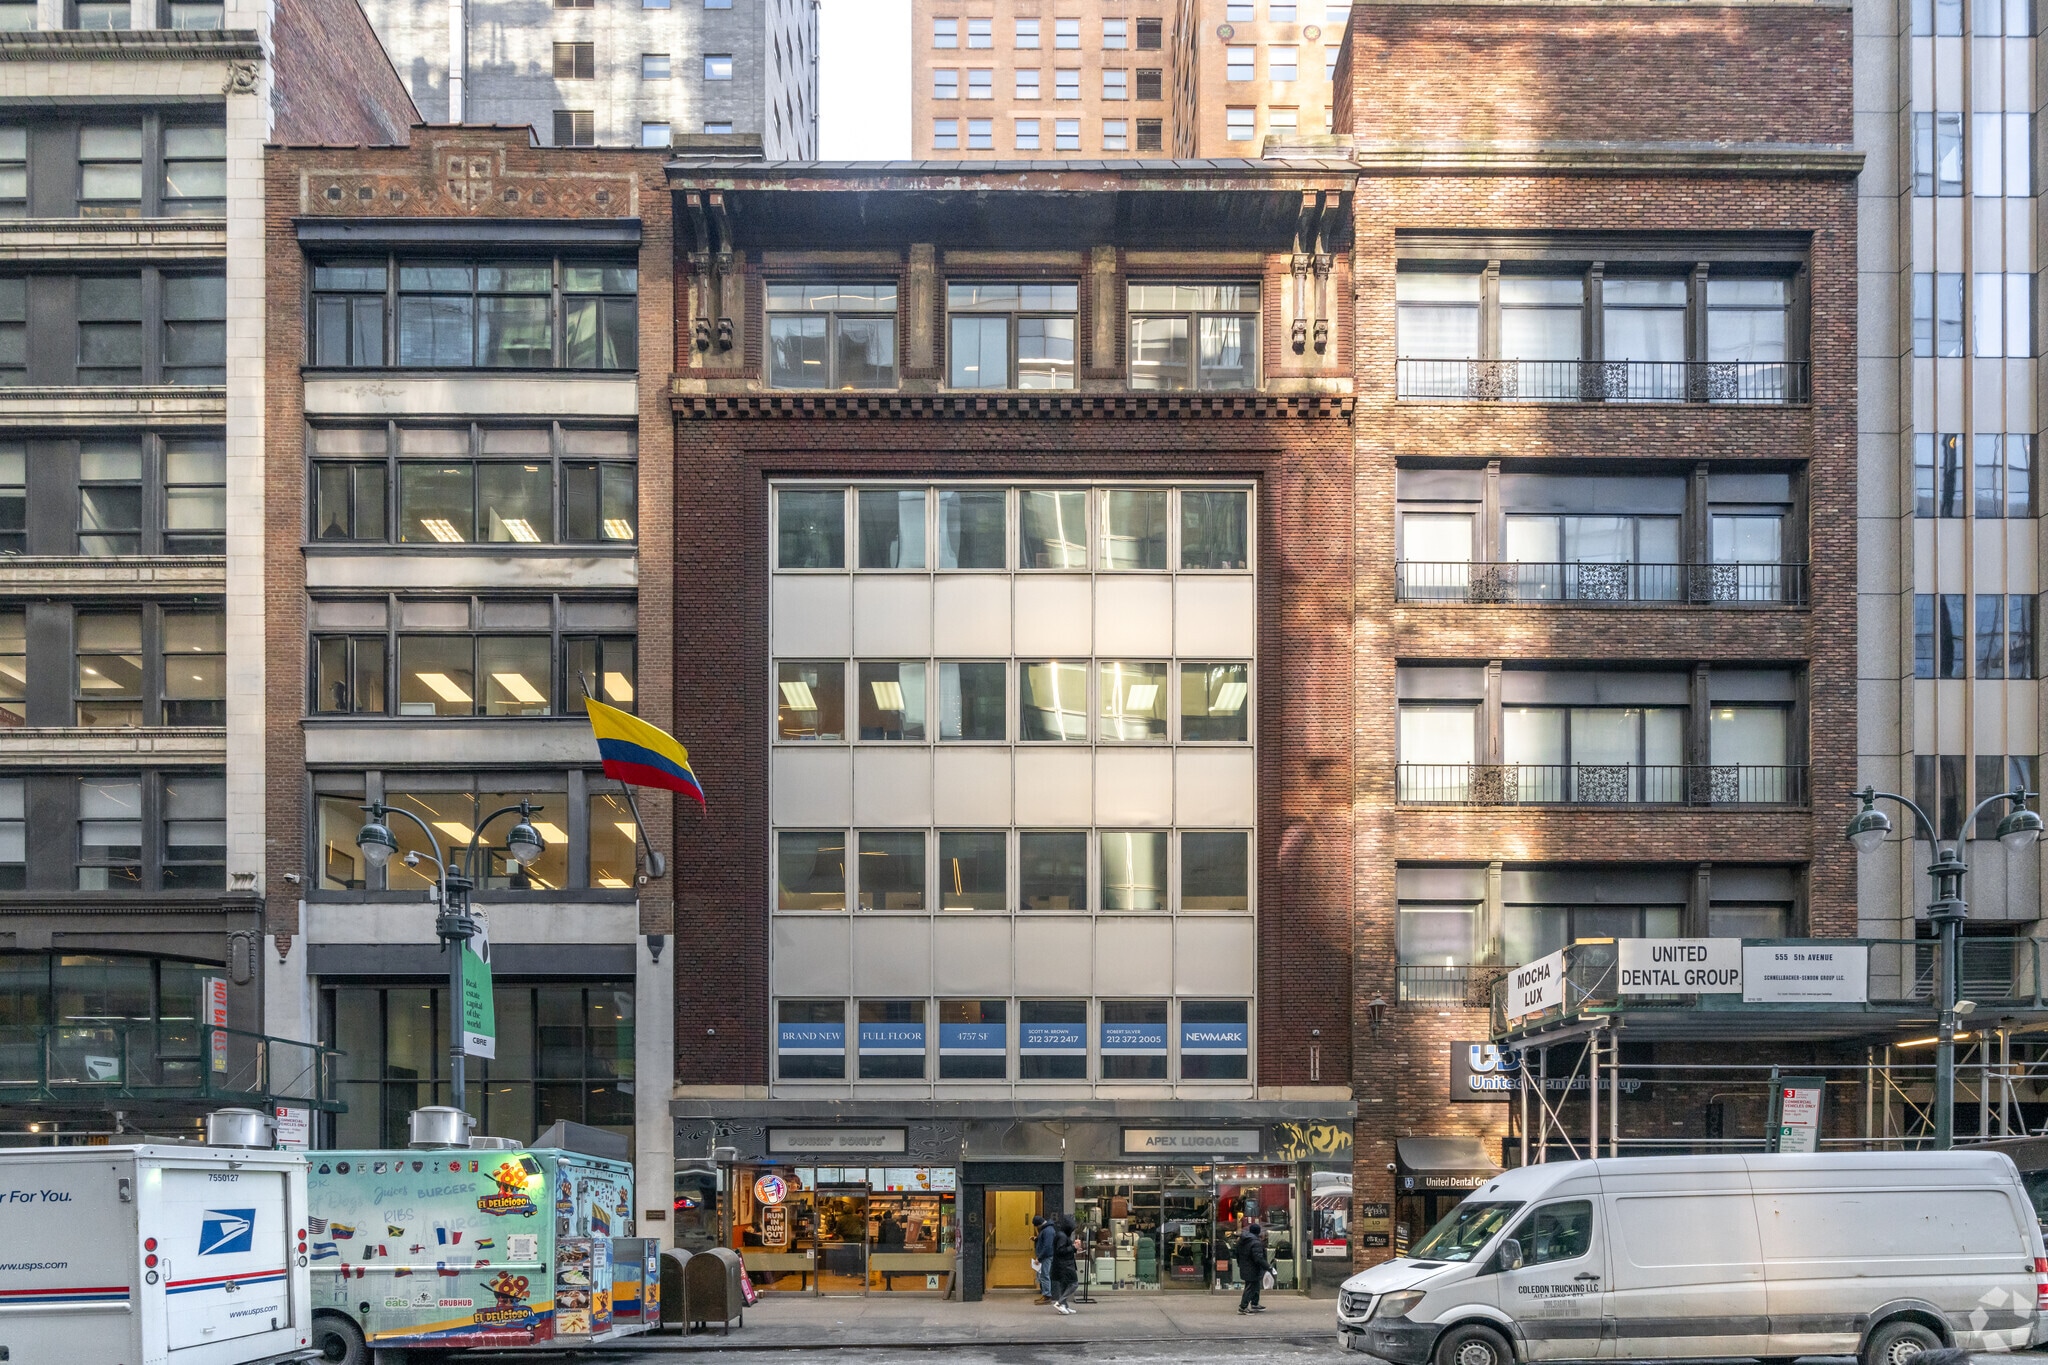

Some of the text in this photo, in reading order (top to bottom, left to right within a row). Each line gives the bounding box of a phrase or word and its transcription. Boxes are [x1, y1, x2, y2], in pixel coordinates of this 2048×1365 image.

[1652, 945, 1708, 962] UNITED
[1774, 953, 1833, 961] 555 5th AVENUE
[1517, 963, 1551, 989] MOCHA
[1621, 968, 1739, 986] DENTAL GROUP
[465, 978, 478, 990] Real
[213, 981, 228, 1007] HOT
[465, 990, 480, 1000] estate
[1524, 987, 1544, 1007] LUX
[465, 1000, 483, 1010] capital
[466, 1010, 481, 1019] of the
[466, 1019, 482, 1030] world
[782, 1031, 842, 1040] BRAND NEW
[862, 1032, 922, 1040] FULL FLOOR
[956, 1032, 990, 1041] 4757 SF
[1028, 1035, 1079, 1043] 212 372 2417
[1106, 1035, 1161, 1043] 212 372 2005
[1186, 1032, 1242, 1042] NEWMARK
[472, 1037, 488, 1047] CBRE
[1786, 1090, 1793, 1098] 3
[280, 1108, 286, 1116] 3
[1783, 1127, 1790, 1135] 6
[1145, 1136, 1240, 1146] APEX LUGGAGE
[208, 1173, 239, 1183] 7550127
[1426, 1176, 1491, 1187] United Dental Gro
[9, 1190, 37, 1203] For
[39, 1189, 73, 1203] You.
[374, 1183, 476, 1206] Juices BURGERS
[478, 1200, 487, 1209] EL
[383, 1208, 415, 1223] RIBS
[0, 1260, 68, 1272] ww.usps.com
[928, 1277, 937, 1286] A
[1518, 1283, 1599, 1294] COLEDON TRUCKING LLC
[385, 1299, 409, 1307] eats
[439, 1299, 472, 1307] GRUBHUB
[229, 1304, 278, 1319] www.usps.com
[474, 1314, 484, 1322] EL
